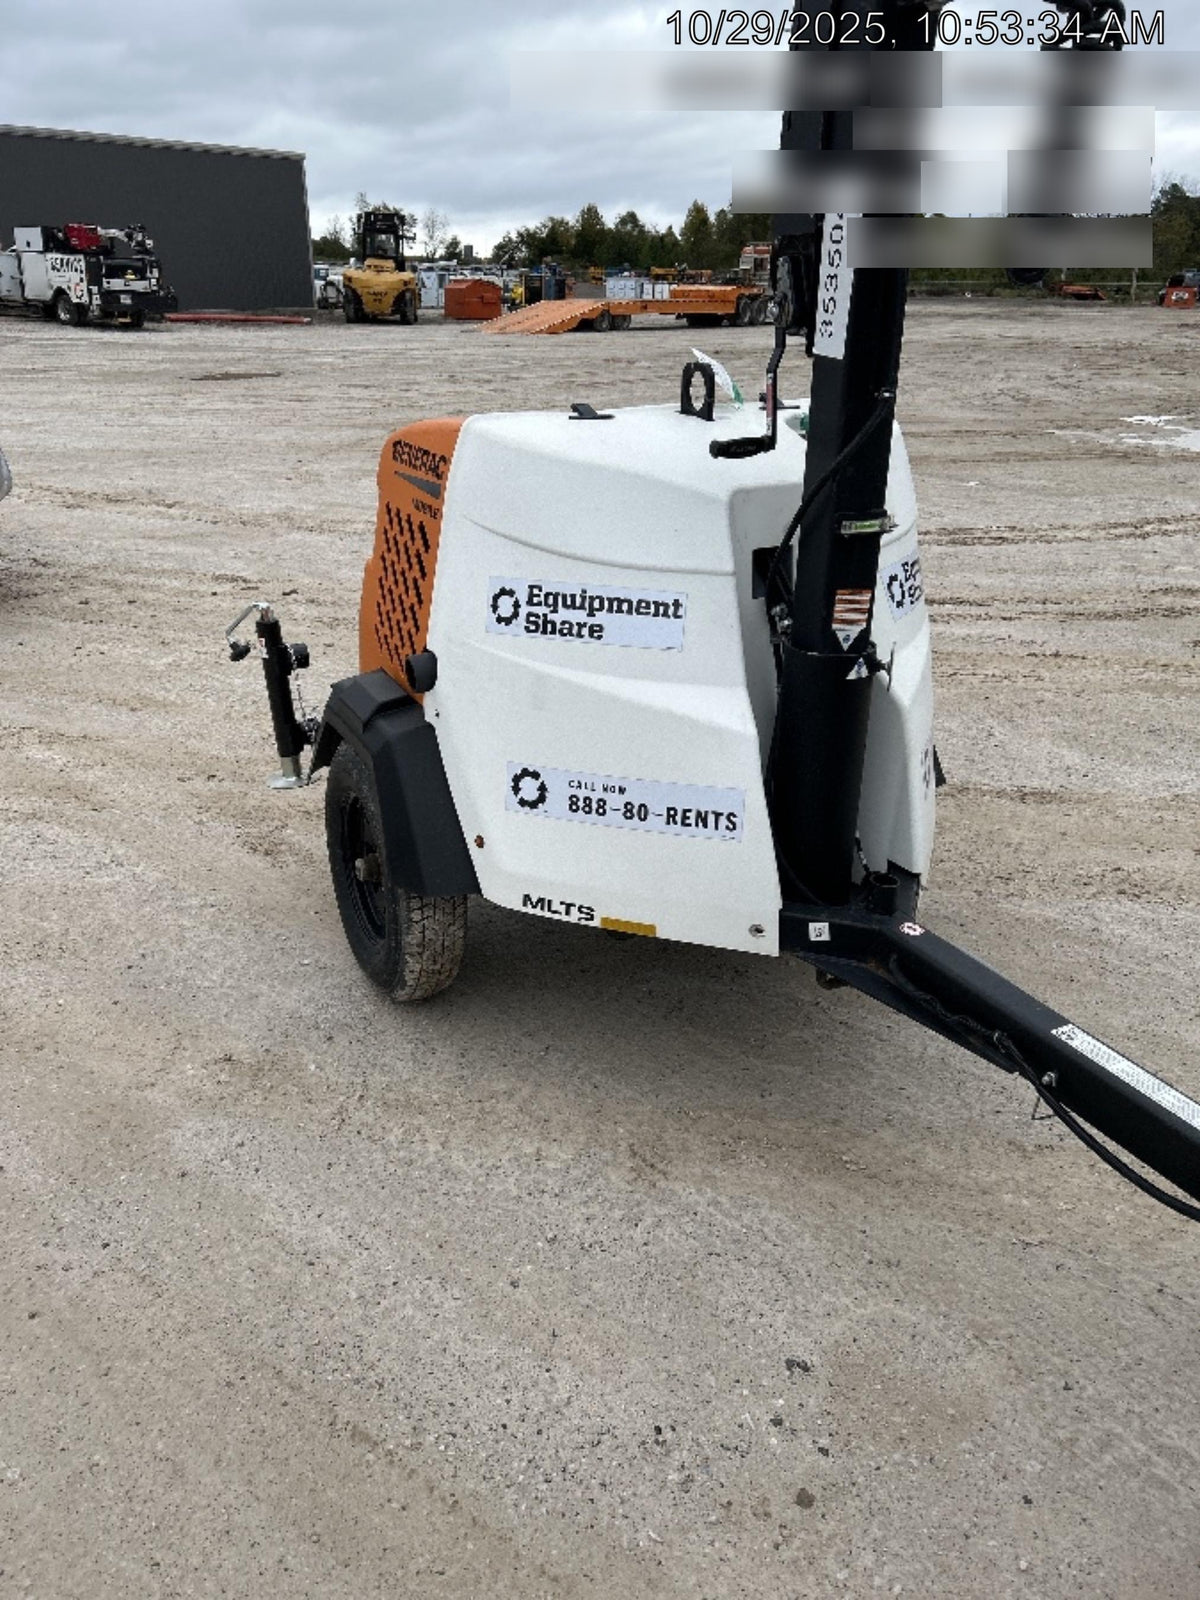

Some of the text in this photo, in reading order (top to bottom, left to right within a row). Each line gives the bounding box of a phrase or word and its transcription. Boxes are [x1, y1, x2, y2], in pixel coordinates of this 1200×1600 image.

[525, 584, 683, 619] Equipment
[523, 611, 604, 640] Share
[568, 779, 627, 796] CALL NOW
[568, 794, 738, 833] 888-80-RENTS
[522, 893, 595, 922] MLTS
